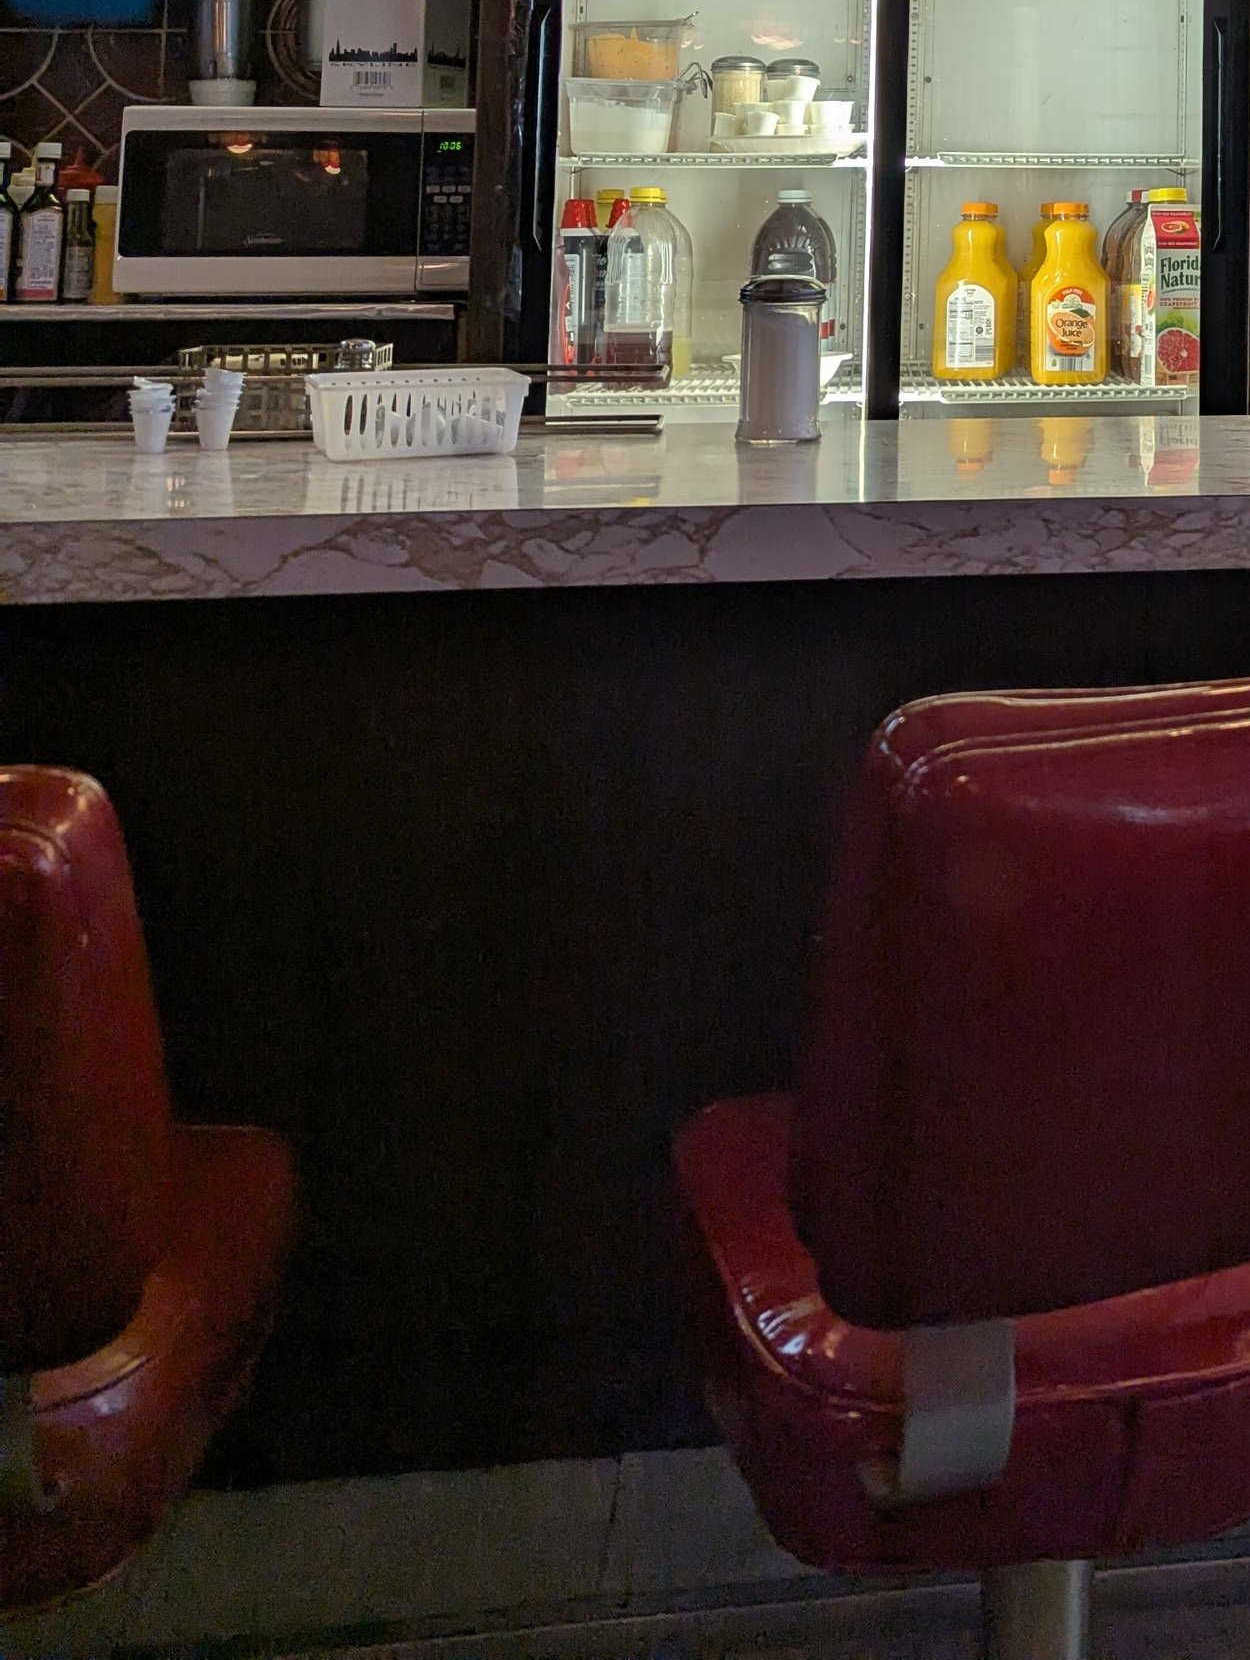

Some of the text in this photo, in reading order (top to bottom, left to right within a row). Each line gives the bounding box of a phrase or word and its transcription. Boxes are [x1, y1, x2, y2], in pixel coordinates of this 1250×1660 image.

[1160, 254, 1200, 275] Florid
[1055, 318, 1088, 329] Orange
[1062, 327, 1082, 338] Juice
